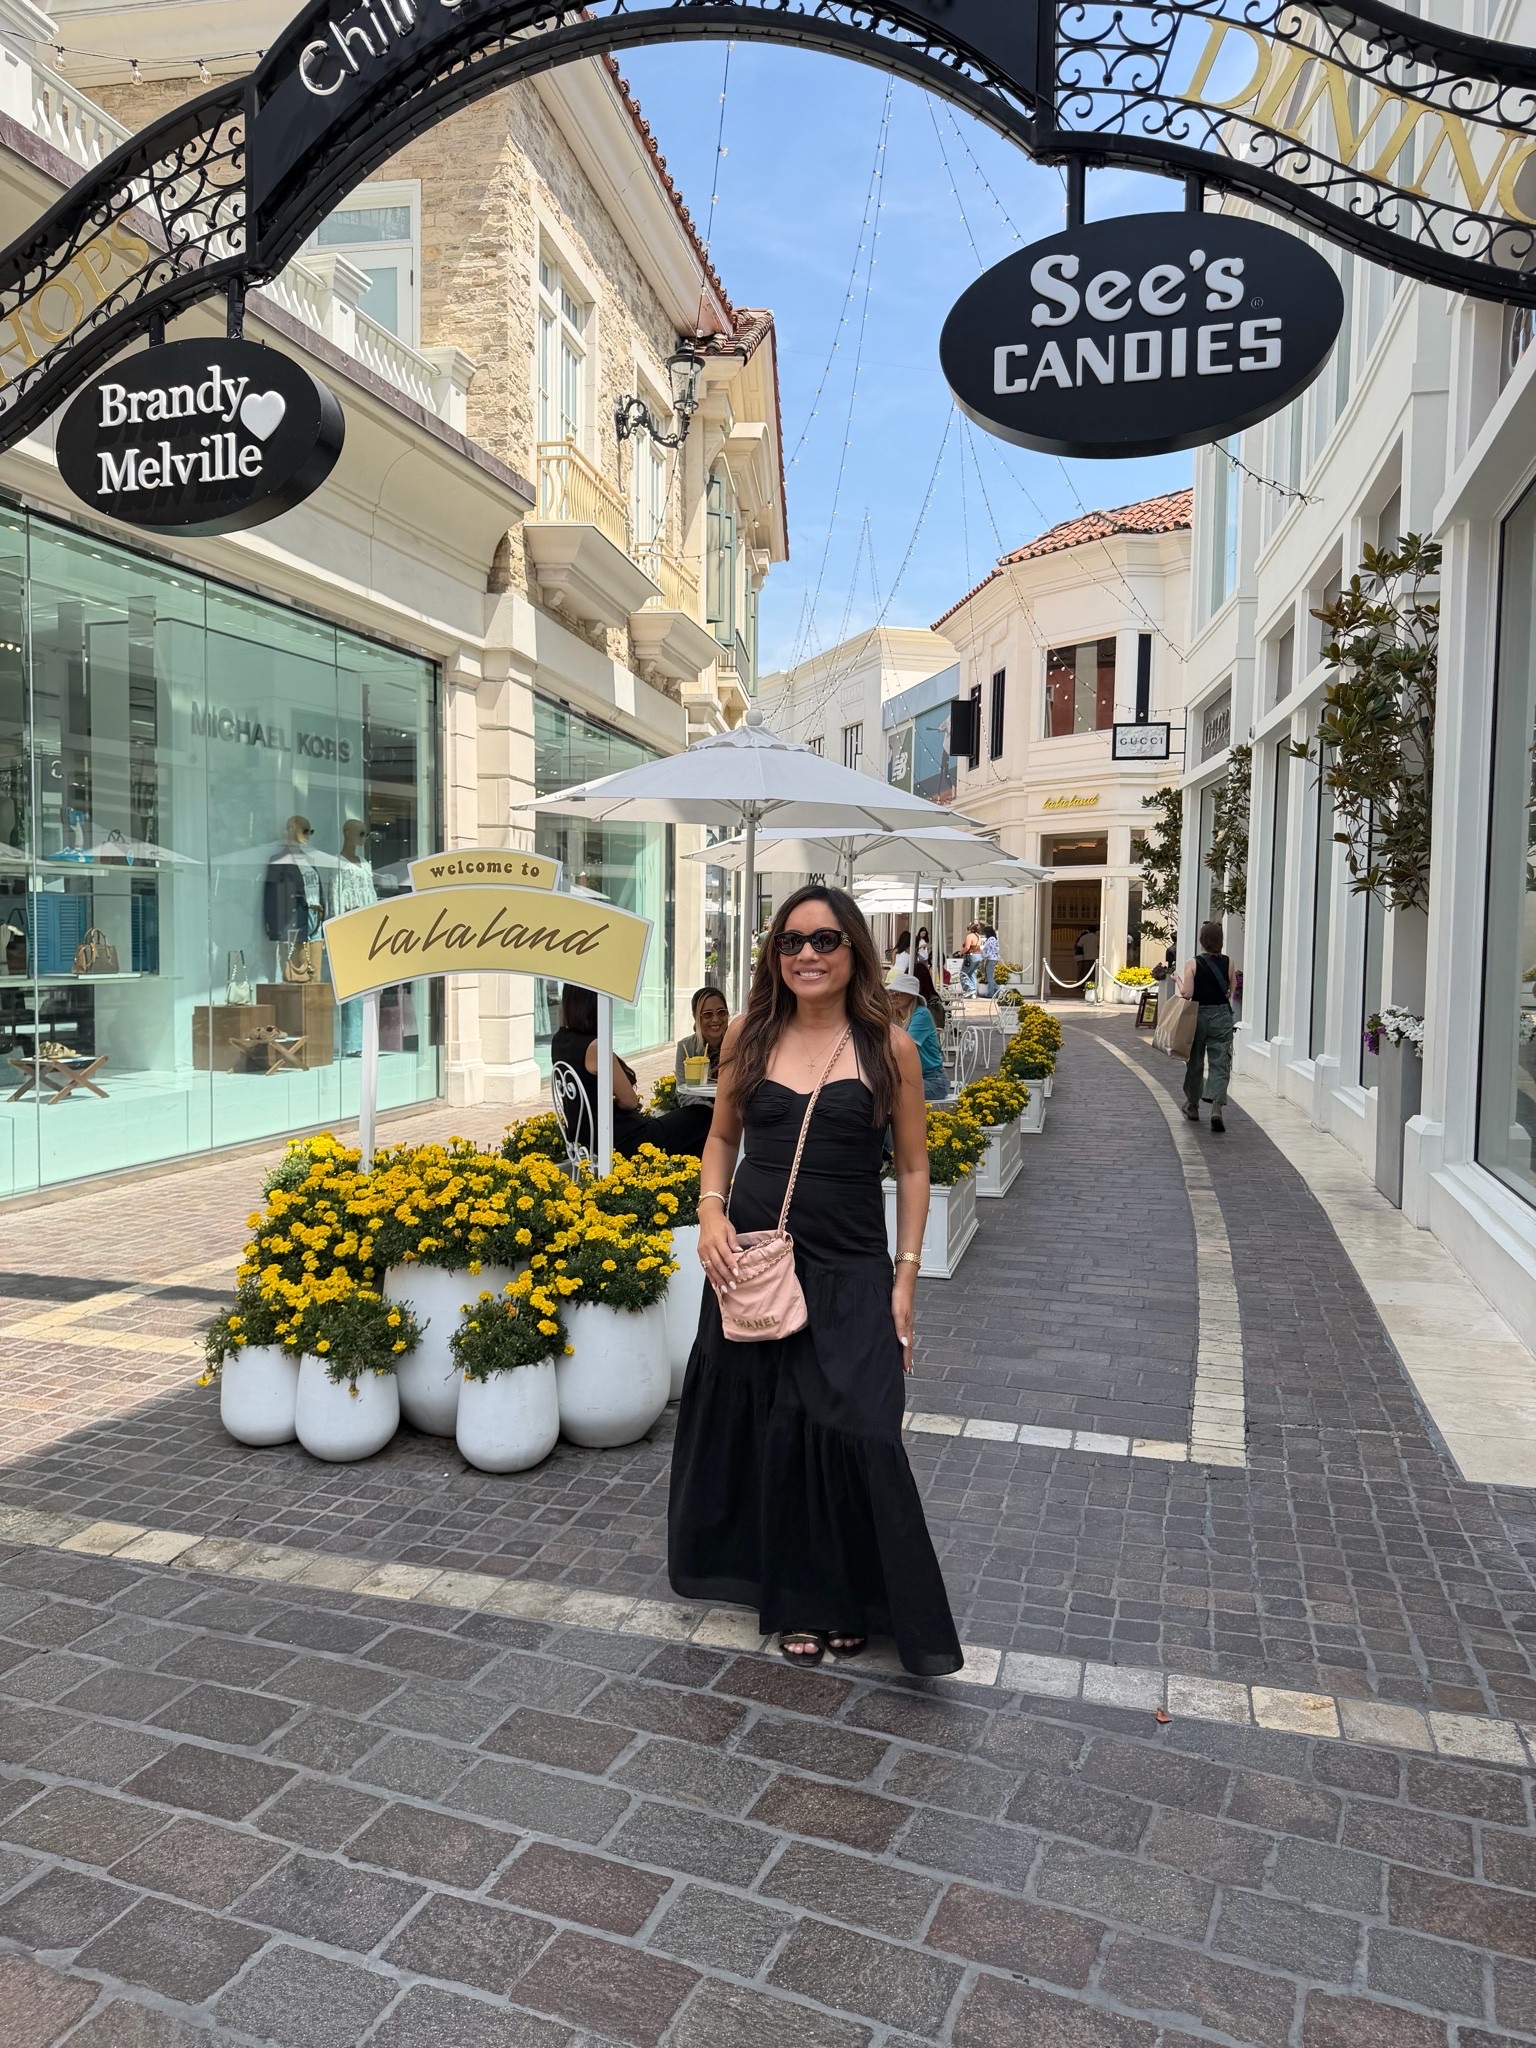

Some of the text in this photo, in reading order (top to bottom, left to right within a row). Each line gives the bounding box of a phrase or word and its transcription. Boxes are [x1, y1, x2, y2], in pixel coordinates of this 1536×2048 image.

[1030, 248, 1245, 329] See's
[992, 316, 1283, 395] CANDIES
[98, 364, 249, 429] Brandy
[96, 433, 263, 496] Melville
[190, 700, 352, 764] MICHAEL KORS
[1119, 737, 1164, 746] GUCCI
[430, 860, 541, 878] welcome to
